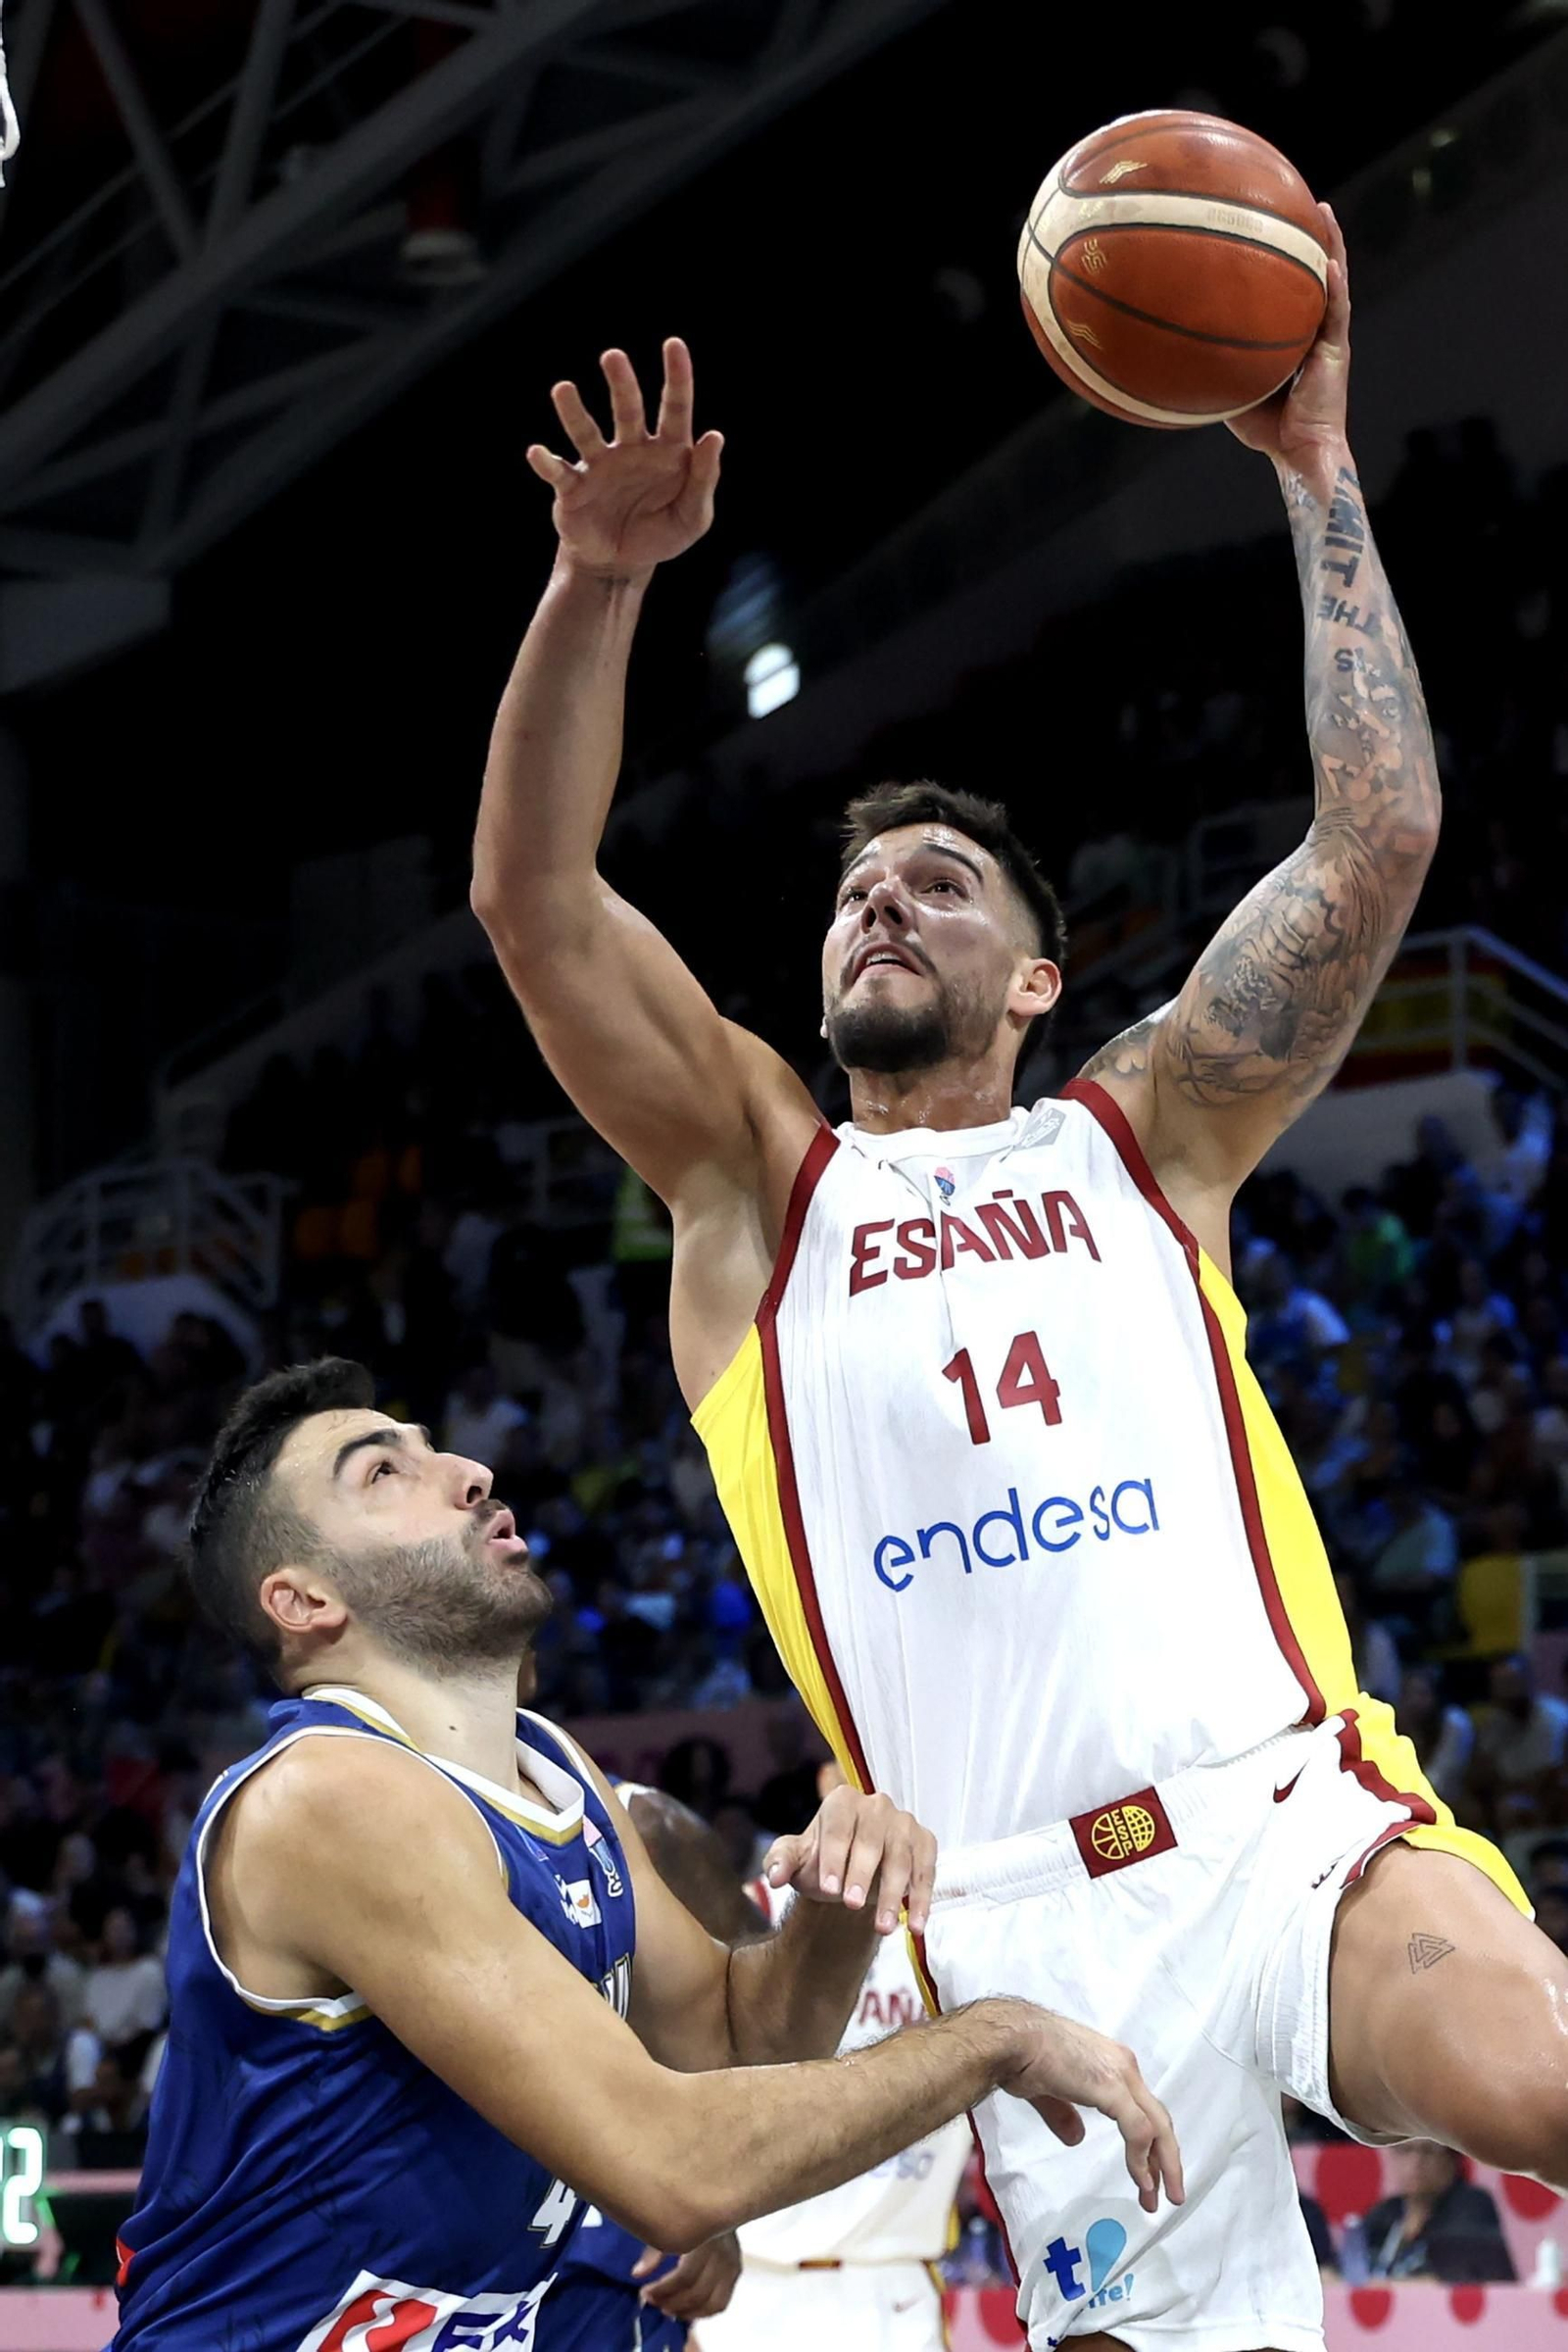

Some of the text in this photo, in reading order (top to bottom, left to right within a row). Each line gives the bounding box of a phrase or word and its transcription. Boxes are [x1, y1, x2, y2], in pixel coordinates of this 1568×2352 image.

[849, 1189, 1102, 1298] ESAÑA
[942, 1331, 1062, 1446] 14
[873, 1478, 1159, 1592] endesa
[1110, 1808, 1134, 1856] ESP
